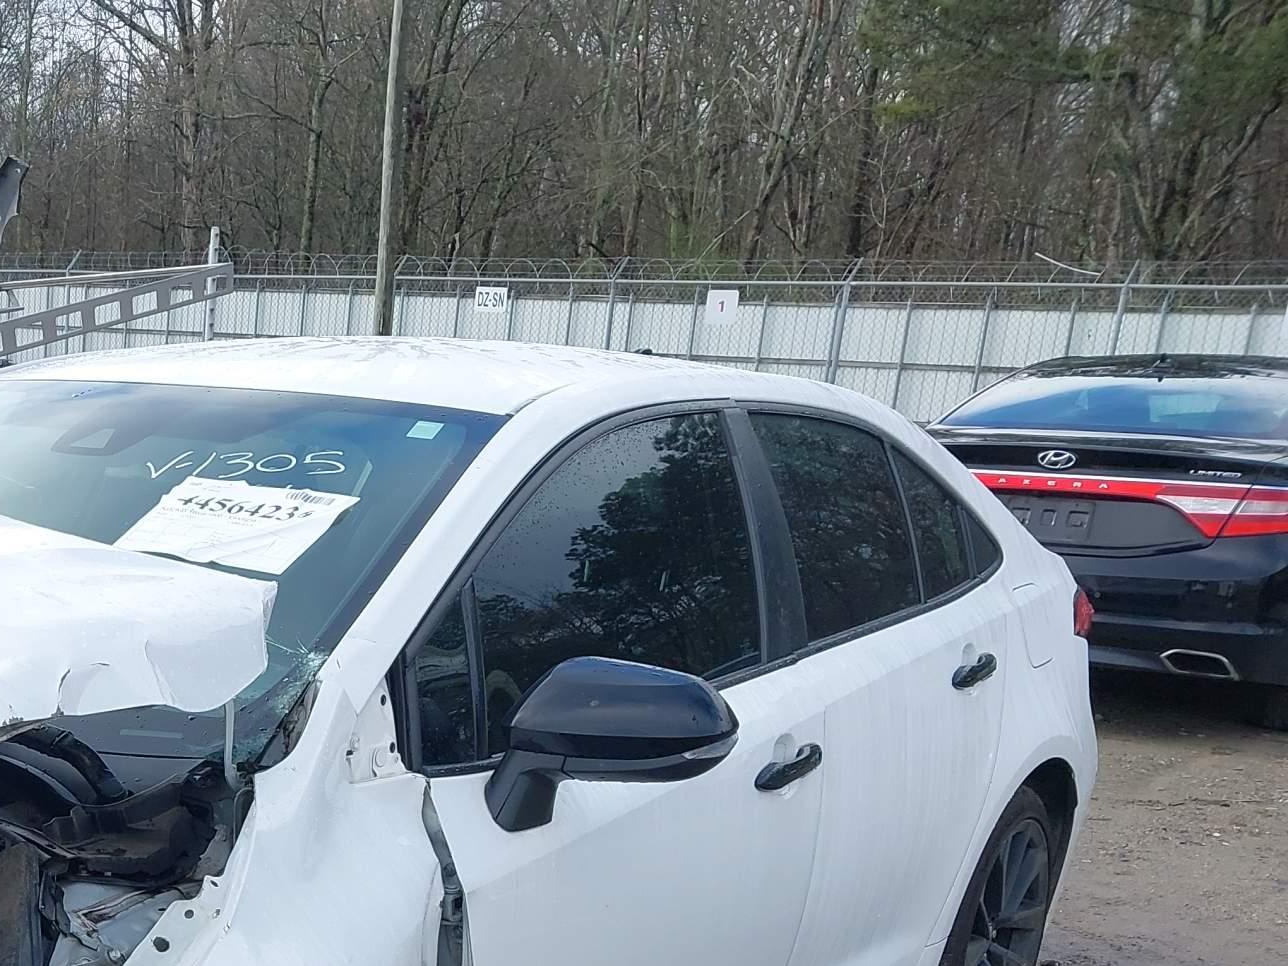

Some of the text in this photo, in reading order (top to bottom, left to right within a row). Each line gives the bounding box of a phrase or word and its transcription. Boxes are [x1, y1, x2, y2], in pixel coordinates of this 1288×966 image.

[477, 291, 505, 308] DZ-SN
[1189, 469, 1242, 479] LIMITED
[998, 477, 1108, 489] AZERA
